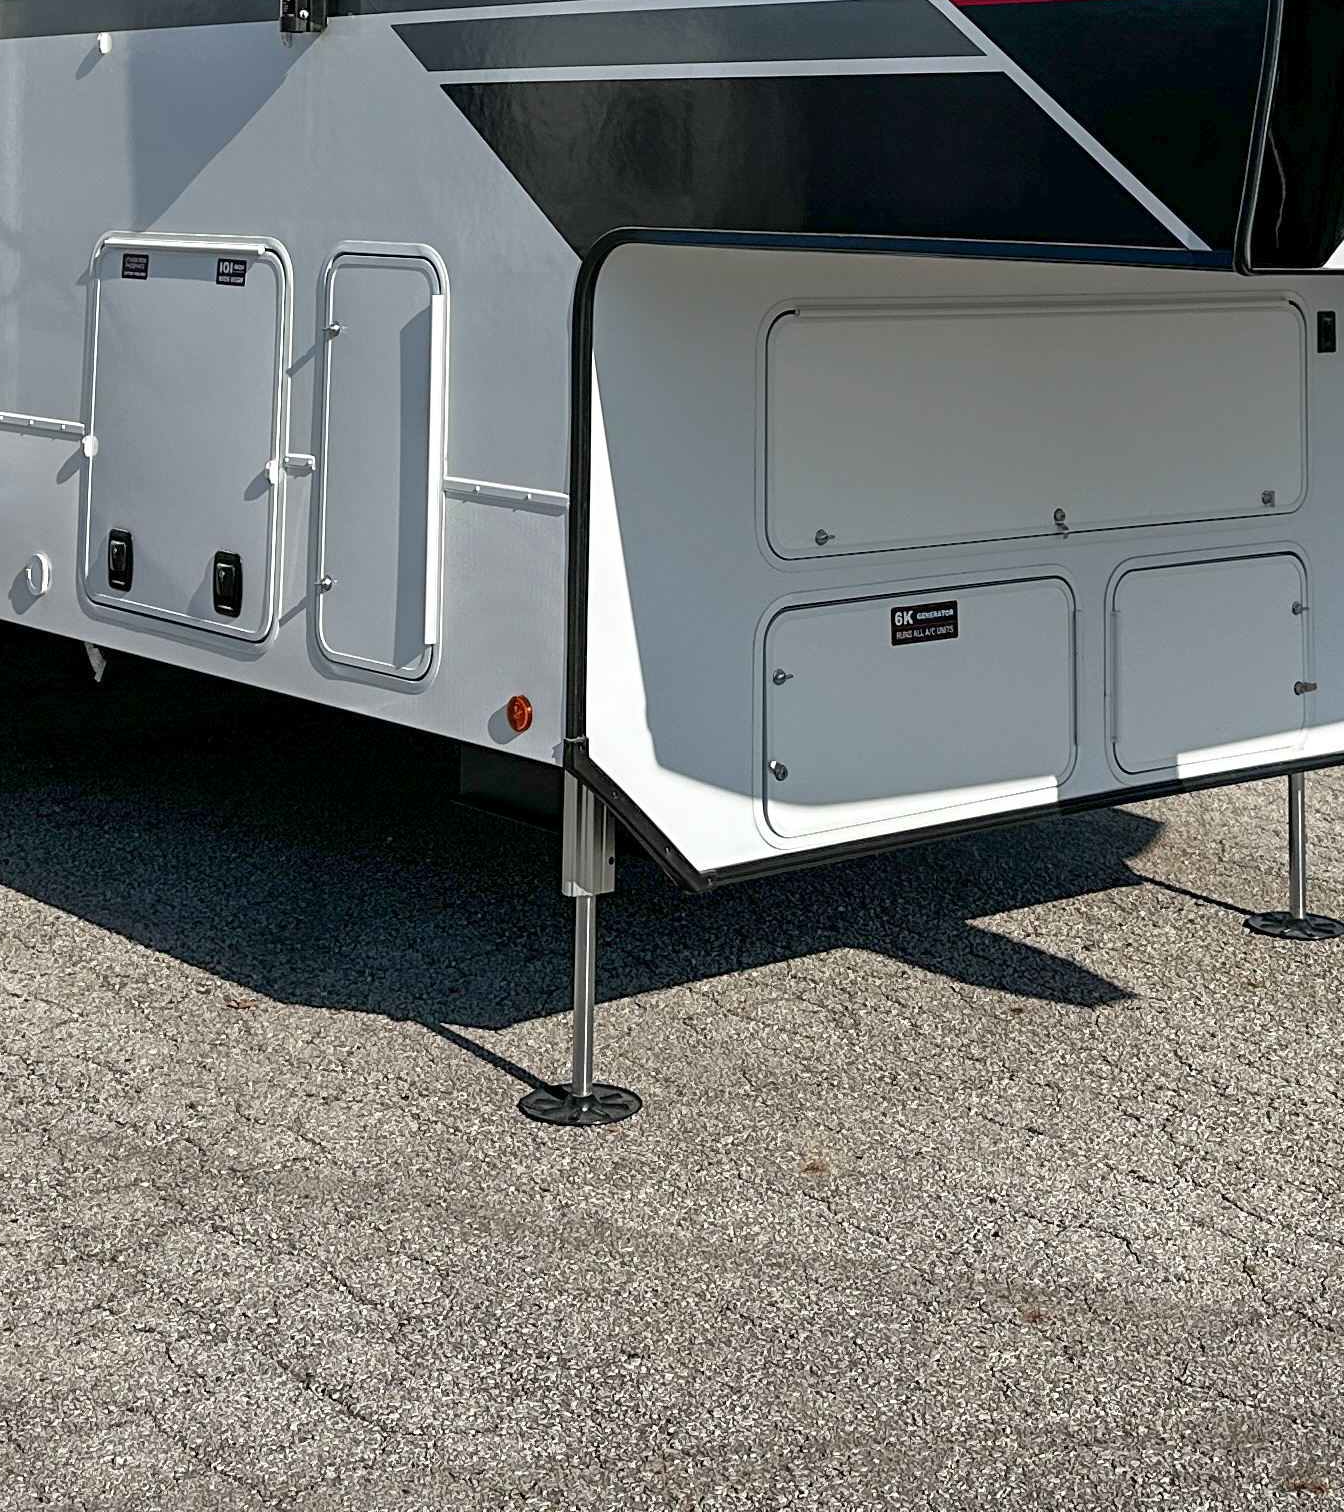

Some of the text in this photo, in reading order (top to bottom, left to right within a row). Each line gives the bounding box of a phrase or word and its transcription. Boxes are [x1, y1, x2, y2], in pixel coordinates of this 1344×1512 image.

[219, 261, 233, 274] 101
[895, 609, 954, 625] 6K GENERATOR
